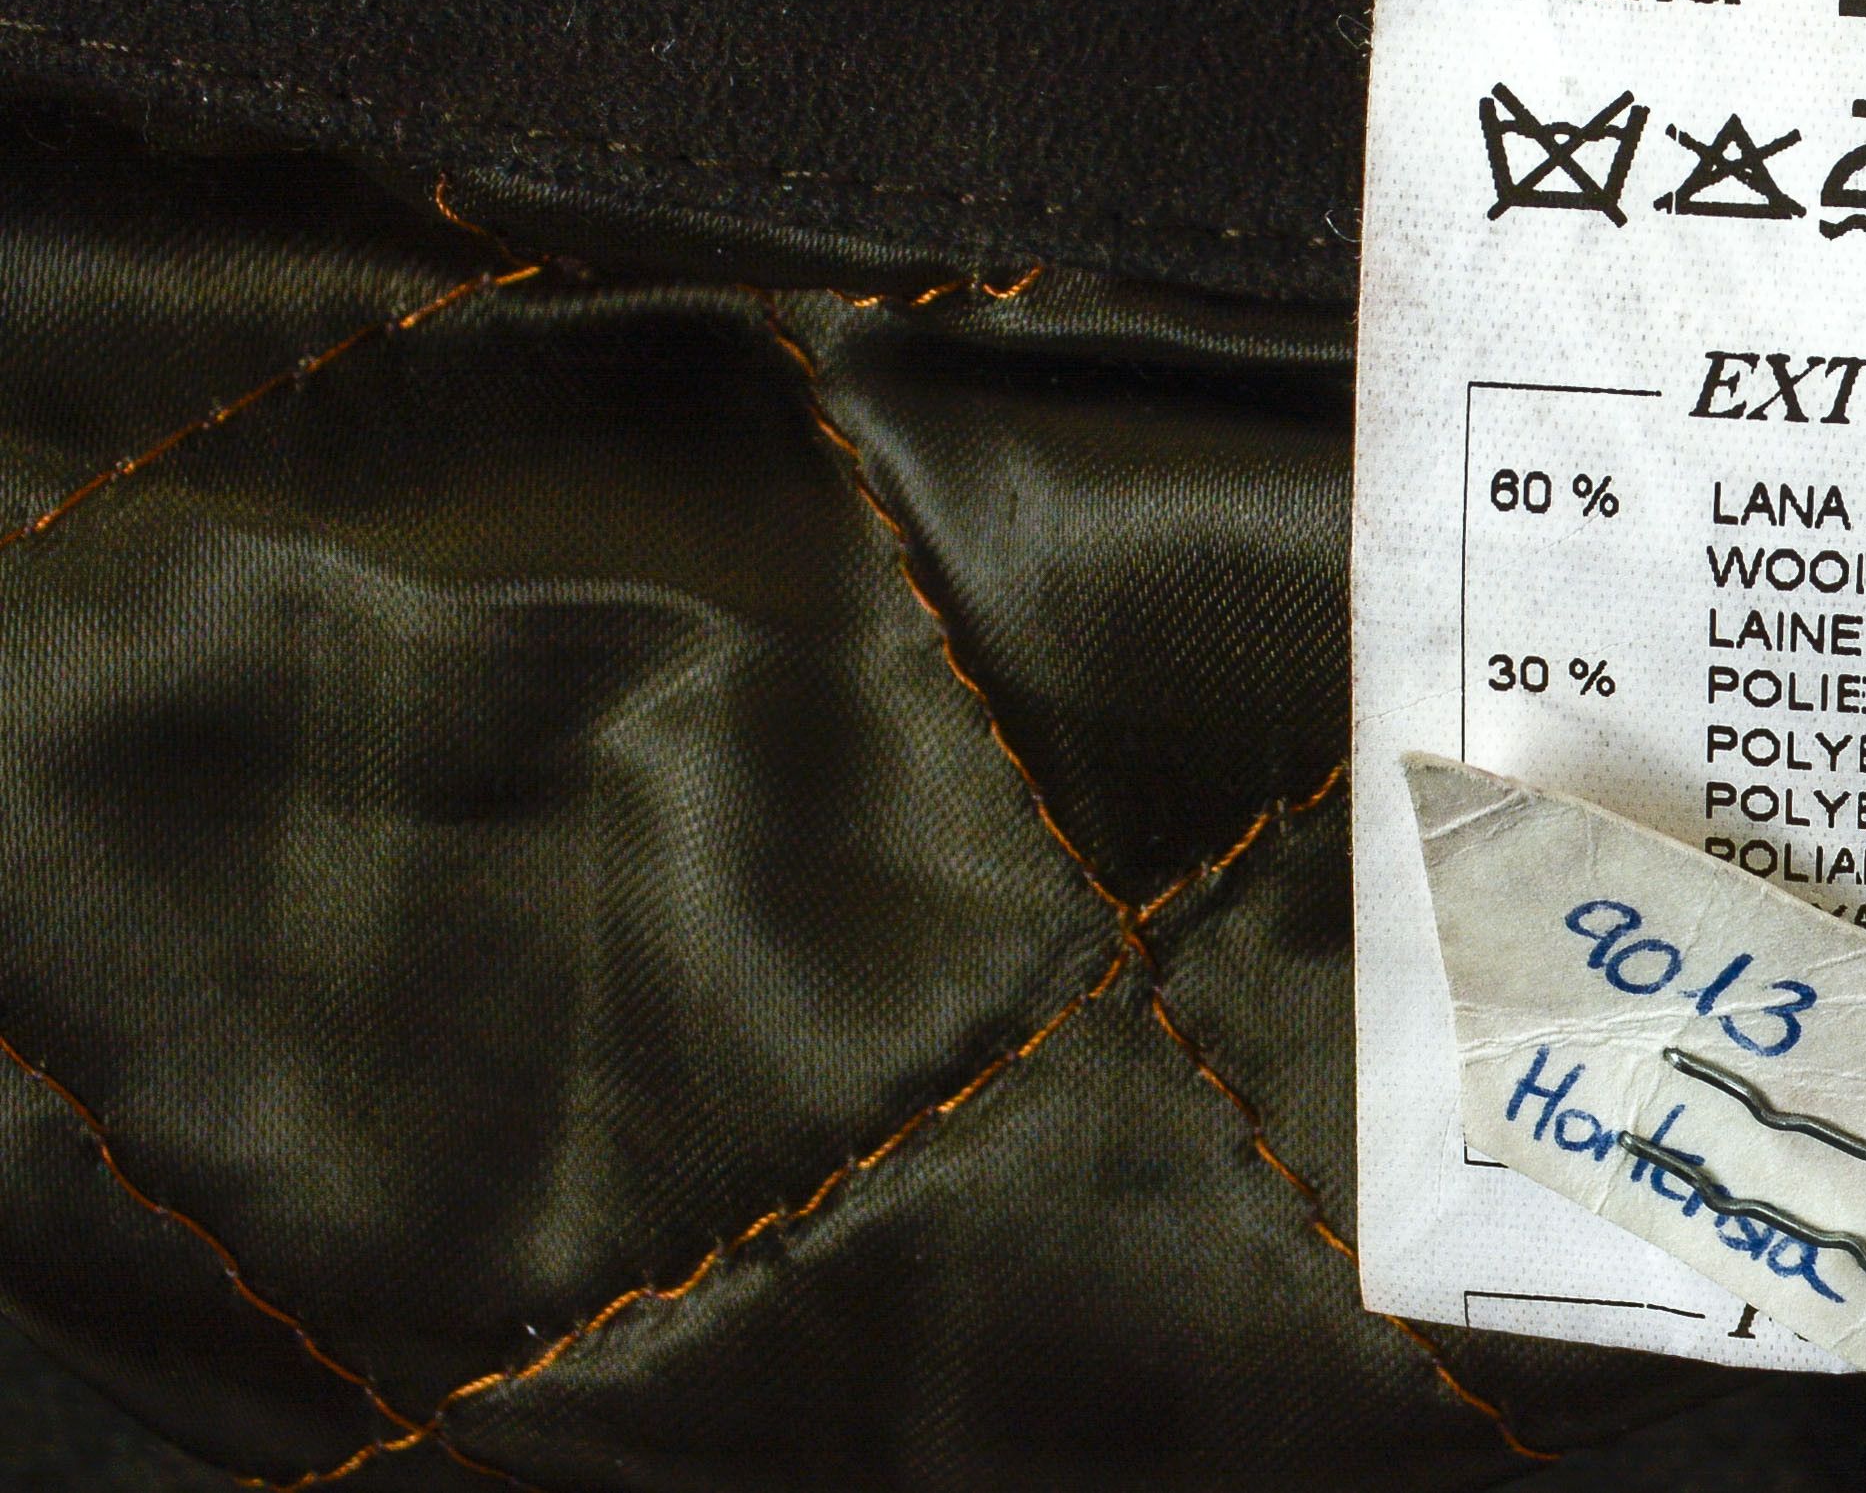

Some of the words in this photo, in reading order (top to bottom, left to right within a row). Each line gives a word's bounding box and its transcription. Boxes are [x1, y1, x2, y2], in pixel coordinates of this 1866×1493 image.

[1491, 469, 1551, 514] 60
[1573, 474, 1619, 517] %
[1714, 482, 1851, 530] LANA
[1710, 609, 1863, 656] LAINE
[1489, 655, 1548, 692] 30
[1569, 658, 1615, 697] %
